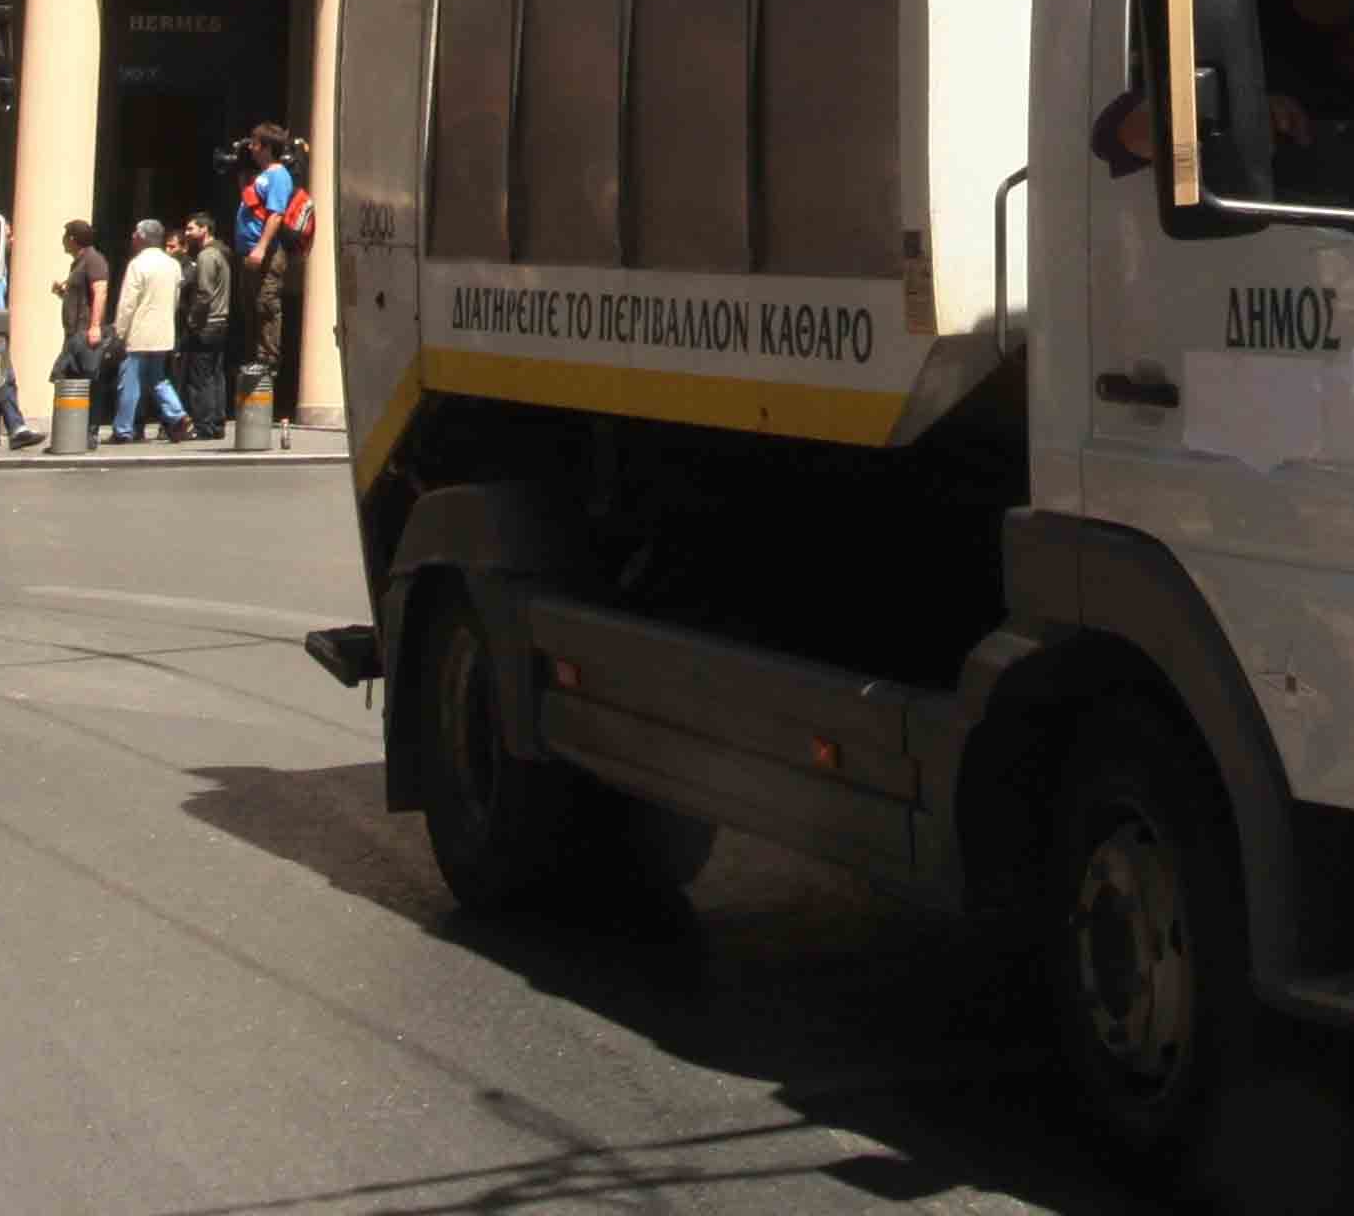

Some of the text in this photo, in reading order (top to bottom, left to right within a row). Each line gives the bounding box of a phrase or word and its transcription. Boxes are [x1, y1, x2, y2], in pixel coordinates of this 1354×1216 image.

[452, 286, 874, 365] ΔΙΑΤΗΡΕΙΤΕ ΤΟ ΠΕΡΙΒΑΛΛΟΝ ΚΑΘΑΡΟ
[1225, 285, 1342, 351] ΔΗΜΟΣ
